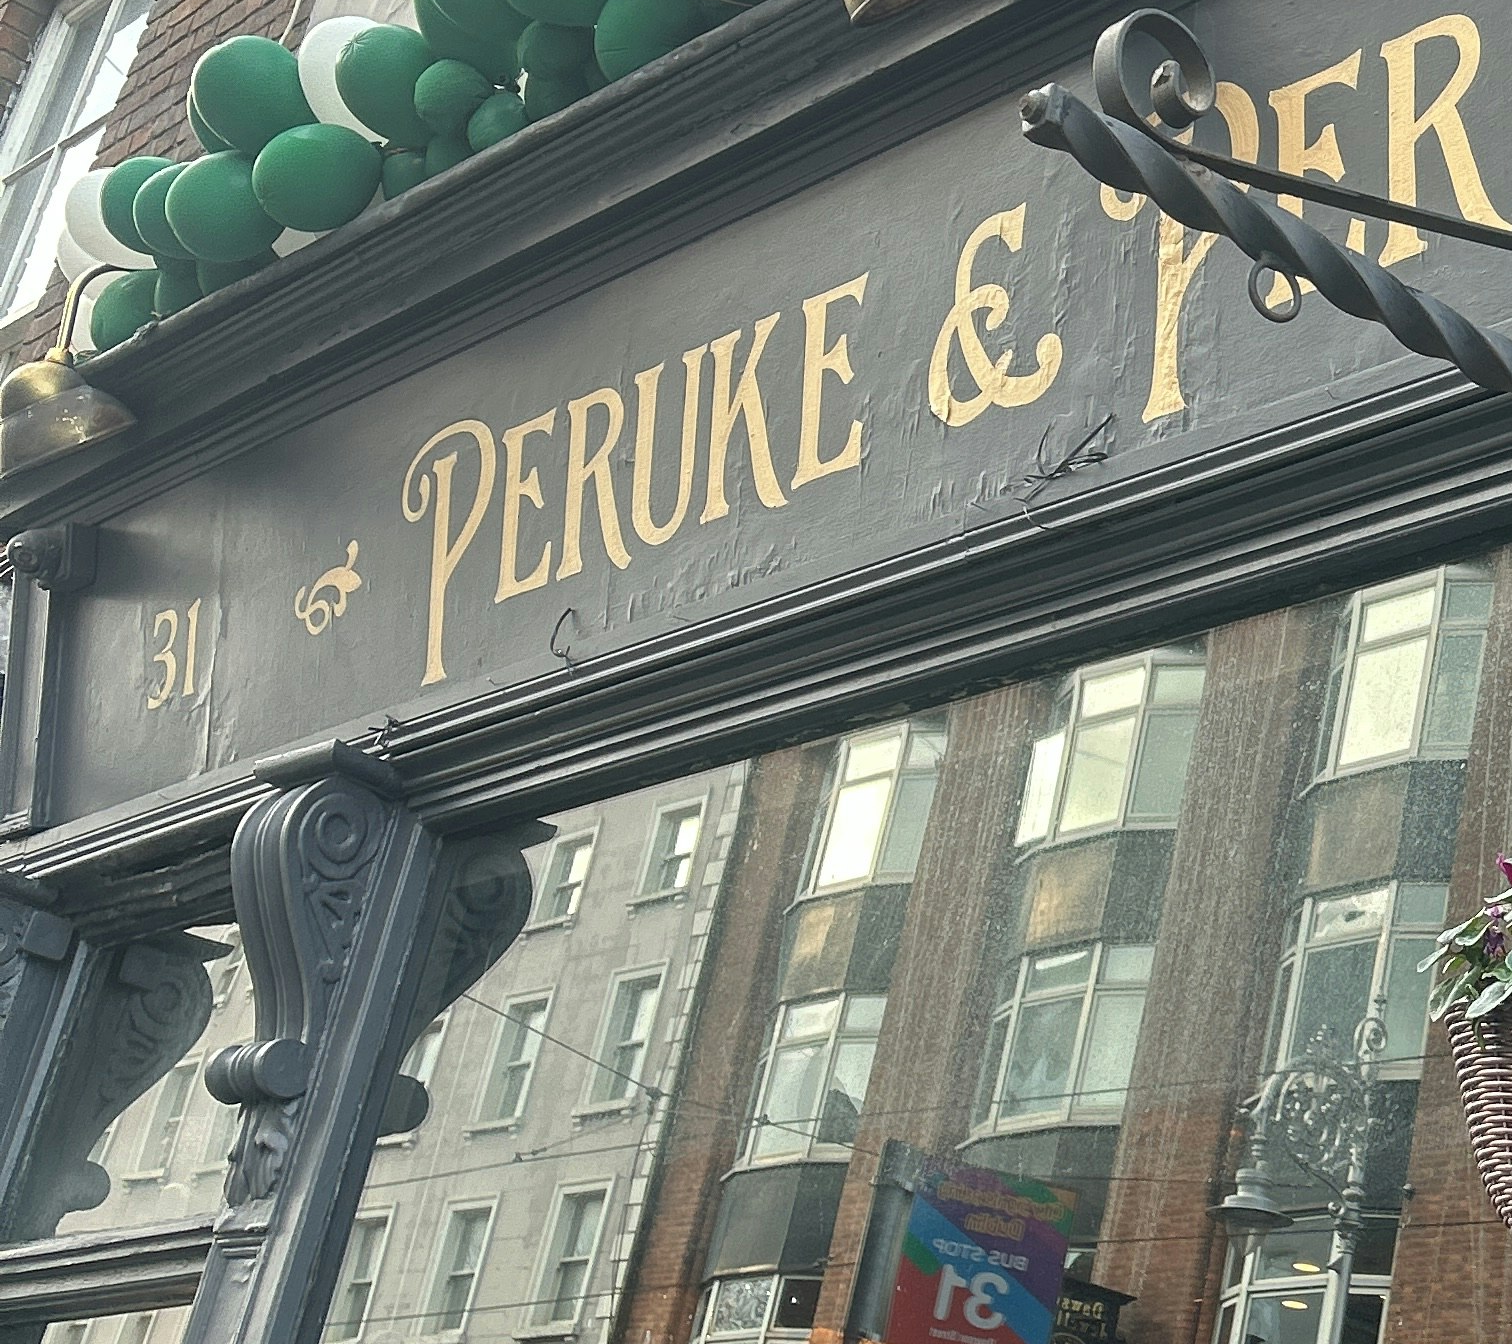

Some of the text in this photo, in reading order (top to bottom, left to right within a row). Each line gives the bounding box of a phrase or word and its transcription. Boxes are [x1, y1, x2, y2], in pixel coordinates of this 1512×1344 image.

[402, 271, 870, 686] PERUKE
[926, 203, 1062, 427] &
[146, 599, 203, 709] 31
